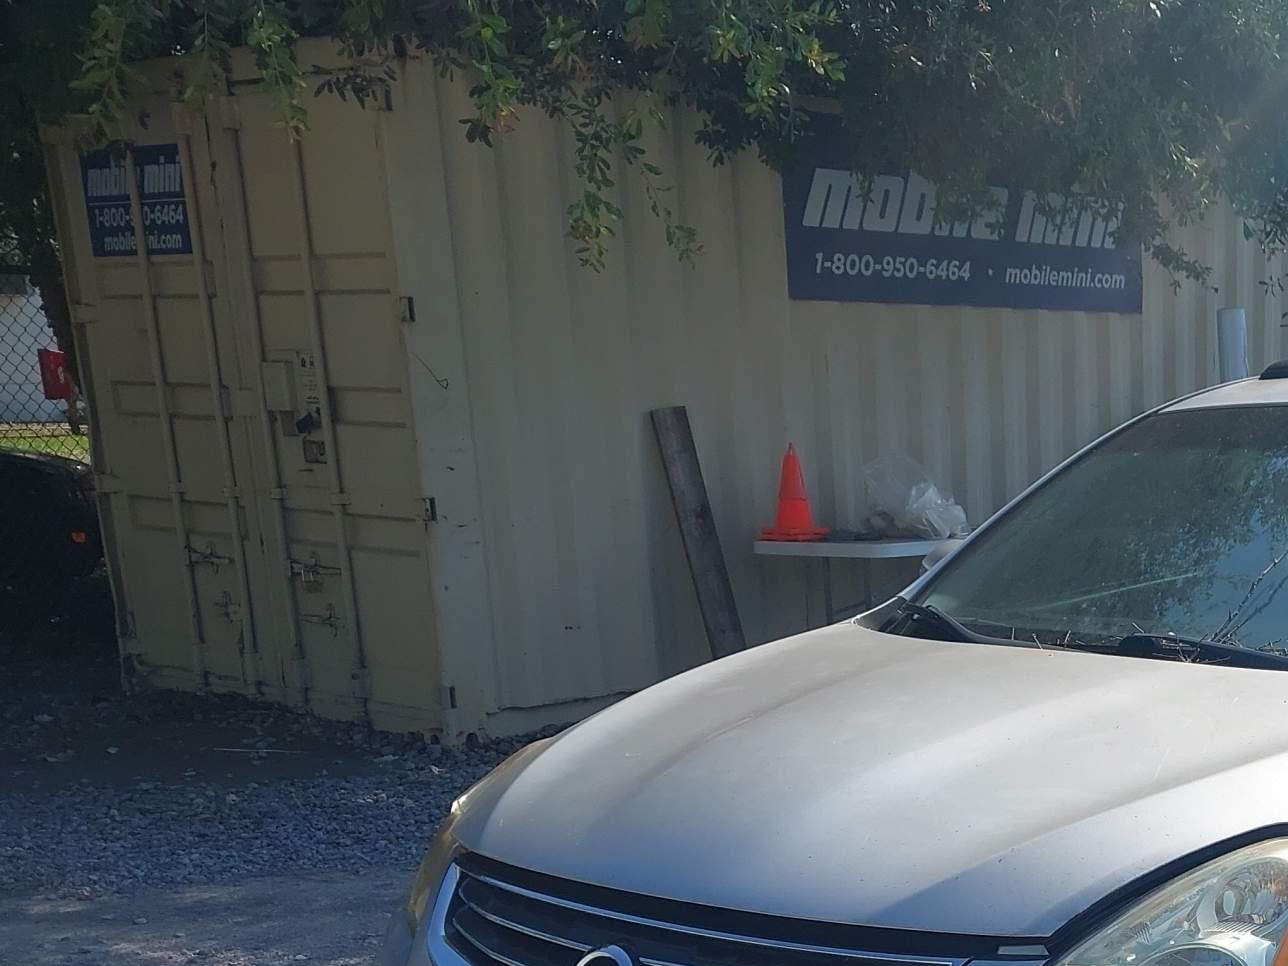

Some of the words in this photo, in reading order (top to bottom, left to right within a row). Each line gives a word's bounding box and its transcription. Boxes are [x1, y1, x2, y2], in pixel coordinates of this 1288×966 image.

[87, 157, 140, 197] mobil
[143, 155, 181, 194] mini
[94, 203, 184, 228] 1-800-0-6464
[103, 230, 183, 252] mobileini.com
[815, 252, 971, 282] 1-800-950-6464
[1005, 263, 1126, 290] mobilemini.com
